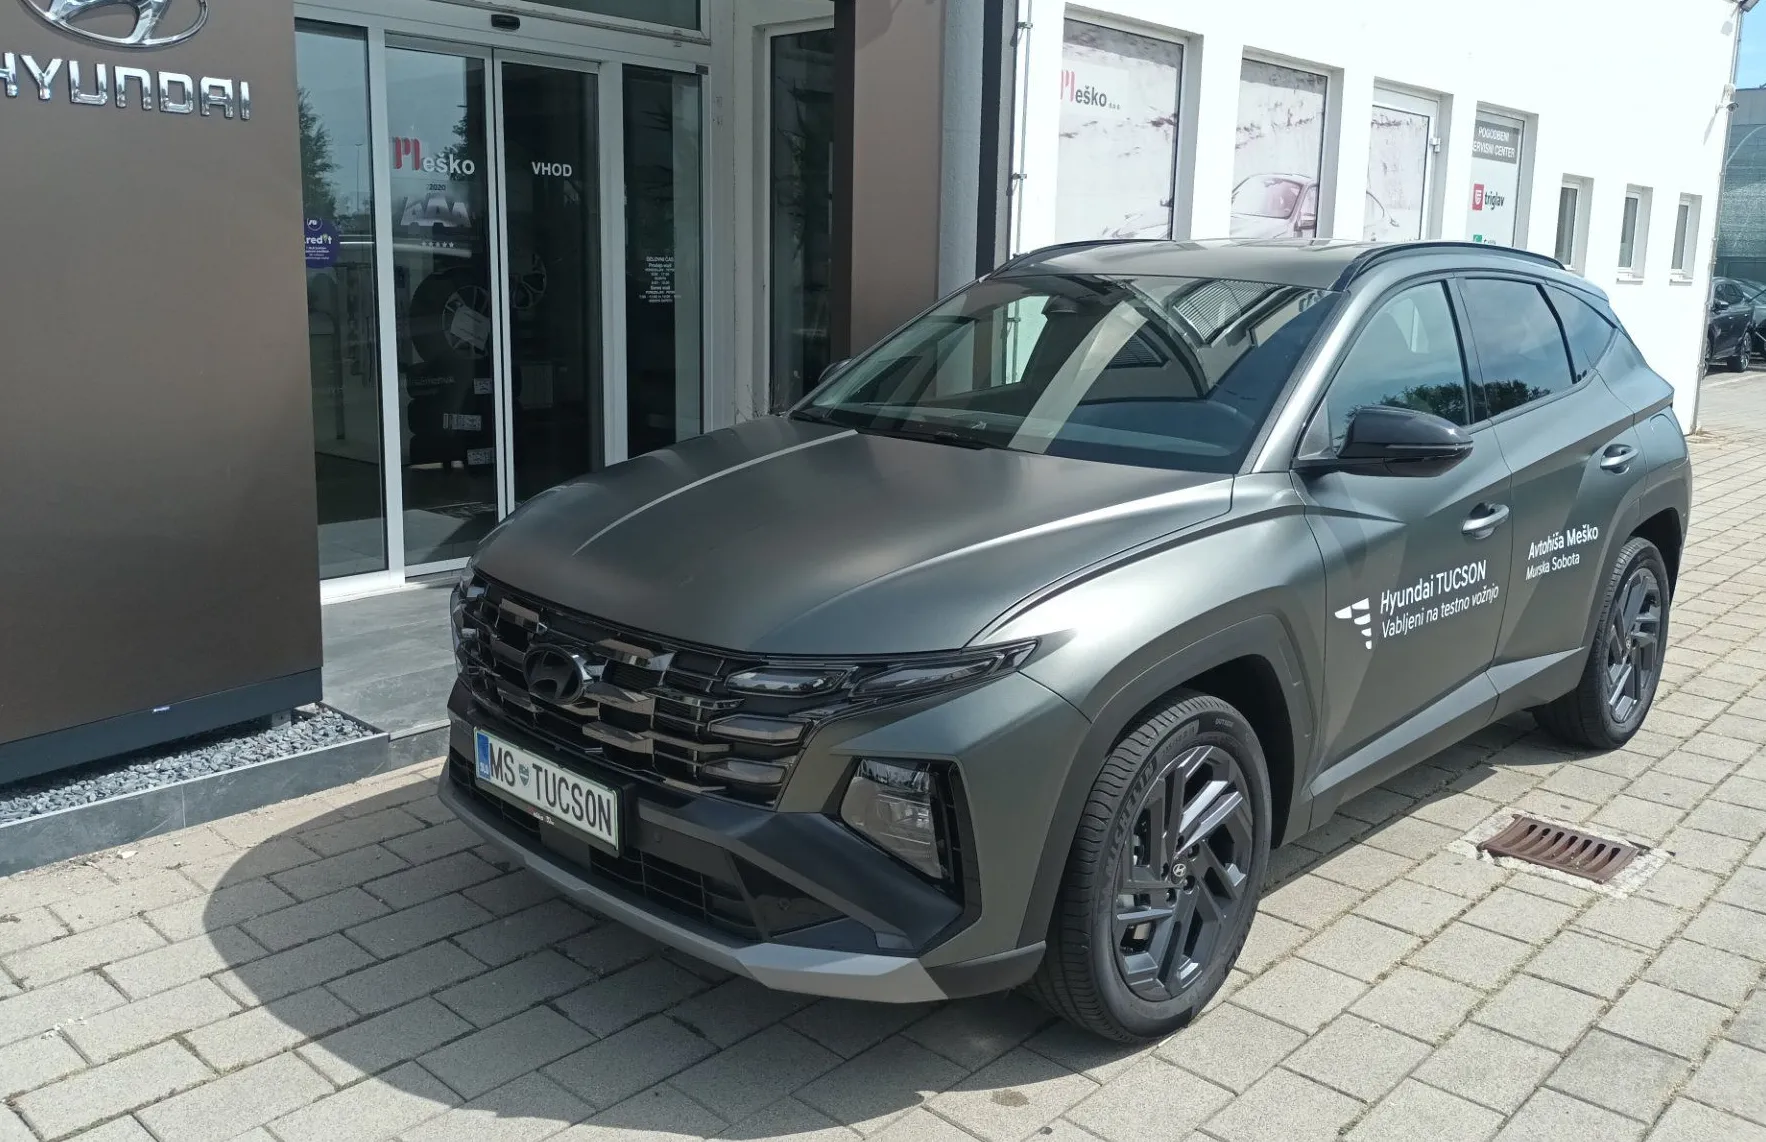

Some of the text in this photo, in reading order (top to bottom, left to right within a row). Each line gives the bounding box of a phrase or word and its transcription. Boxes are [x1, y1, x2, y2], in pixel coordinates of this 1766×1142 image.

[1060, 69, 1107, 107] Meško
[1473, 141, 1515, 158] ERVISNI CENTER
[1478, 126, 1510, 142] POGODBENI
[394, 136, 475, 175] Meško
[531, 161, 573, 178] VHOD
[1484, 191, 1505, 210] triglav
[1528, 524, 1599, 560] Avtohiša Meško
[1525, 552, 1580, 581] Murska Sobota
[1380, 560, 1487, 616] Hyundai TUCSON
[1382, 583, 1499, 638] Vabljeni na testno vožnjo
[490, 743, 612, 837] MS TUCSON
